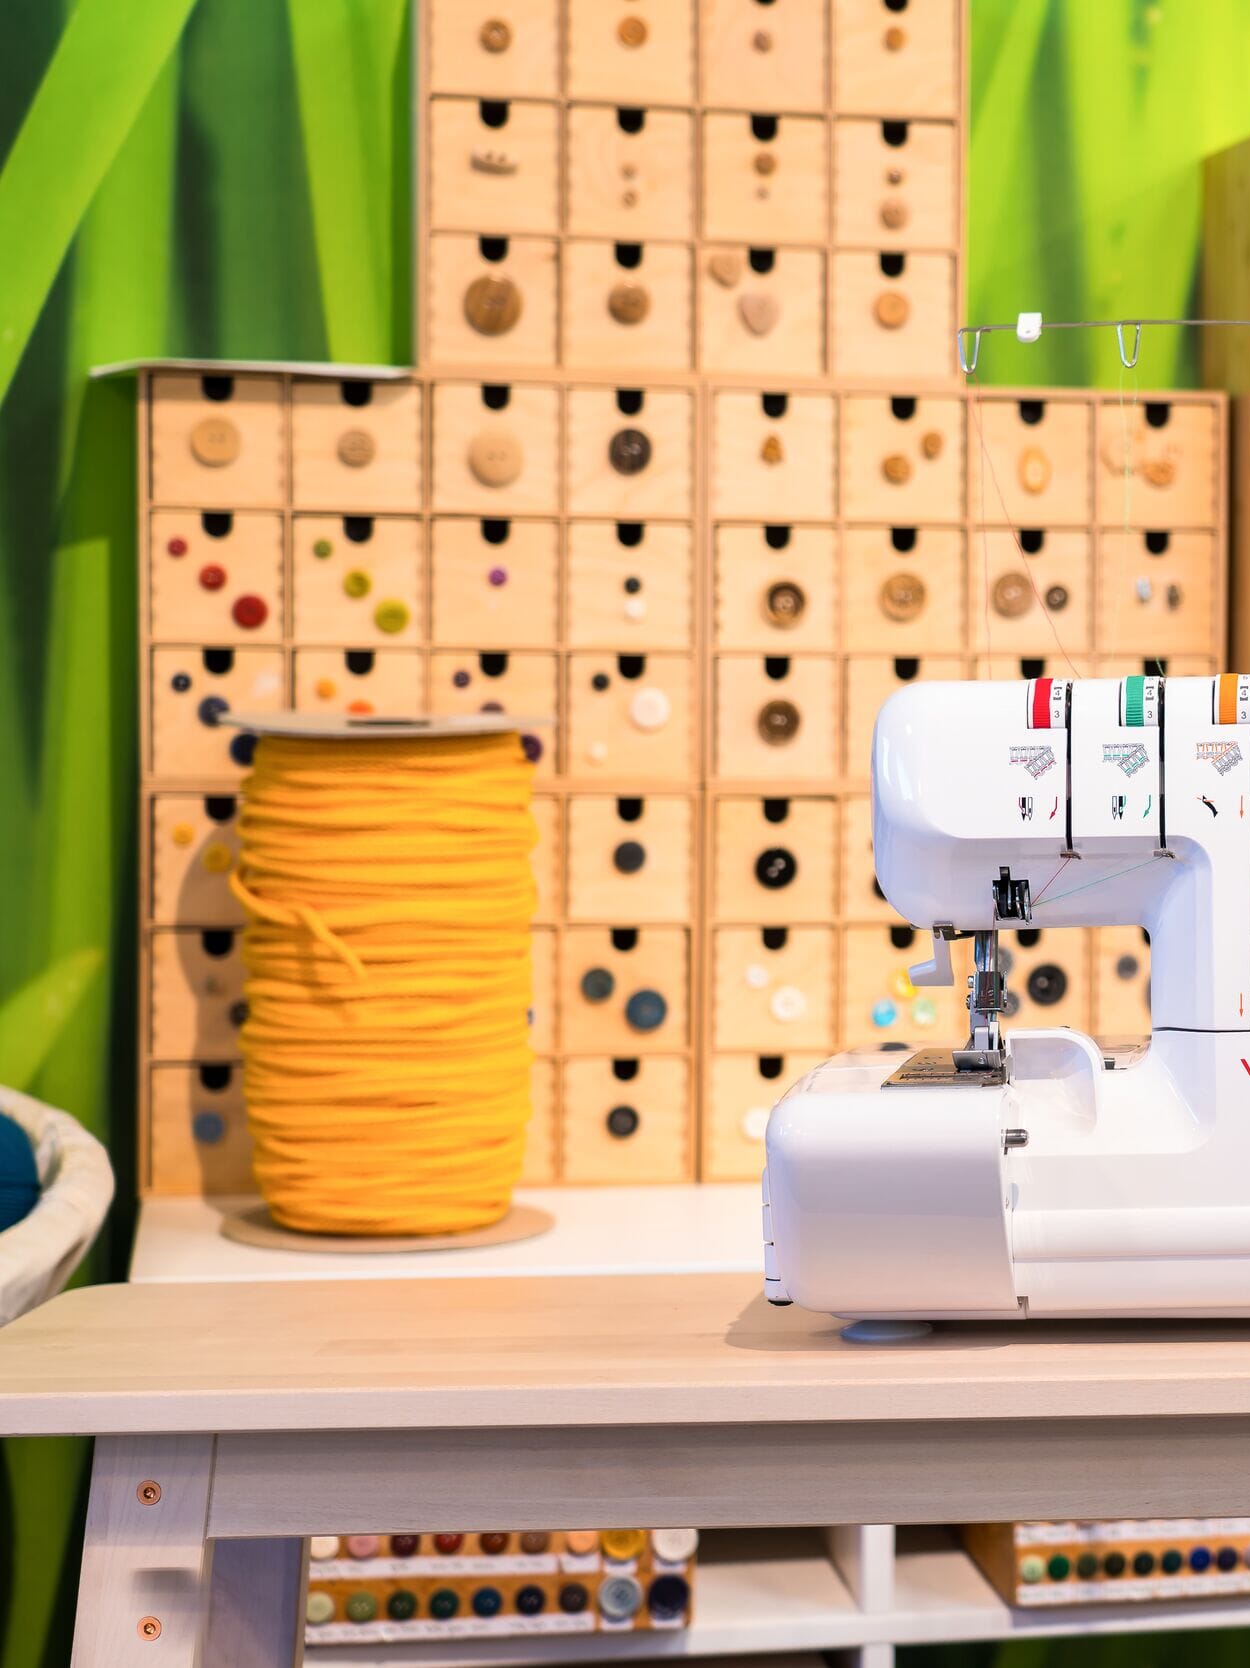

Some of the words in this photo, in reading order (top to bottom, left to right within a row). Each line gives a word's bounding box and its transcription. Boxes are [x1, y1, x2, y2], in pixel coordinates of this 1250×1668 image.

[1054, 710, 1060, 718] 3
[1147, 710, 1153, 719] 3
[1241, 711, 1247, 719] 3
